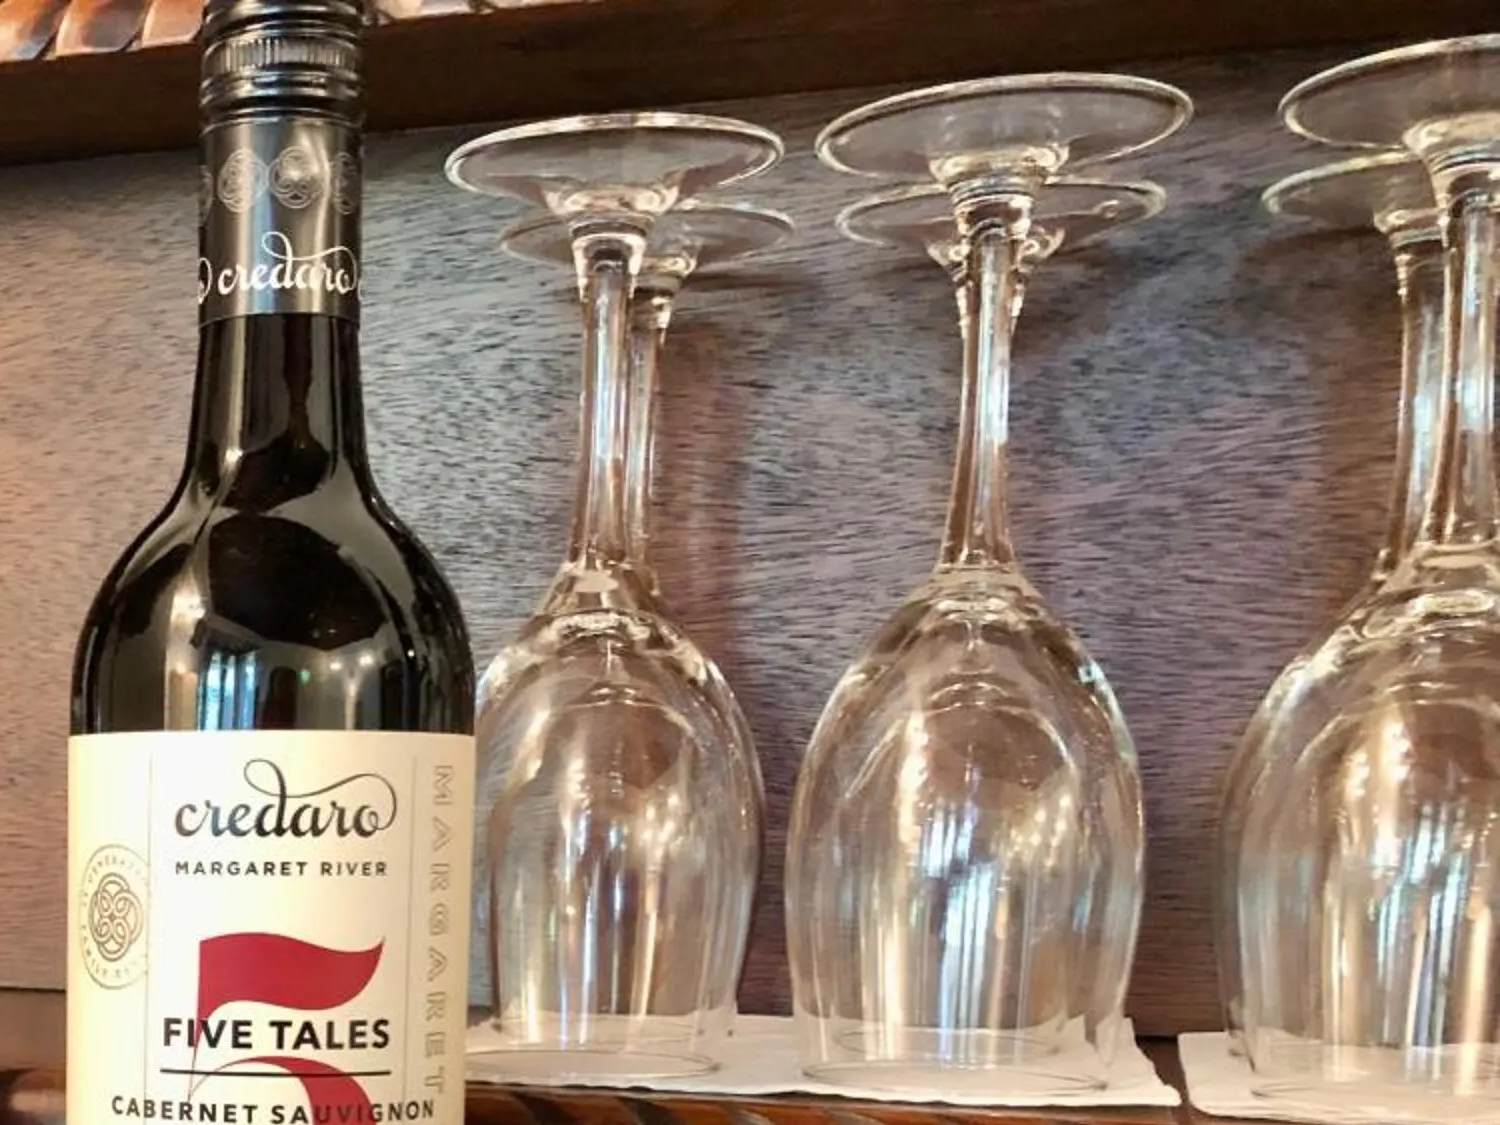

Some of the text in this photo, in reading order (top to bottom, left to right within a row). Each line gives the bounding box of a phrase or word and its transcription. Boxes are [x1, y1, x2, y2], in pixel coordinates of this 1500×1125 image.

[218, 231, 358, 295] credaro
[175, 758, 397, 838] credaro
[175, 861, 388, 877] MARGARET RIVER
[163, 1017, 390, 1050] FIVE TALES
[112, 1095, 434, 1125] CABERNET SAUVIGNON
